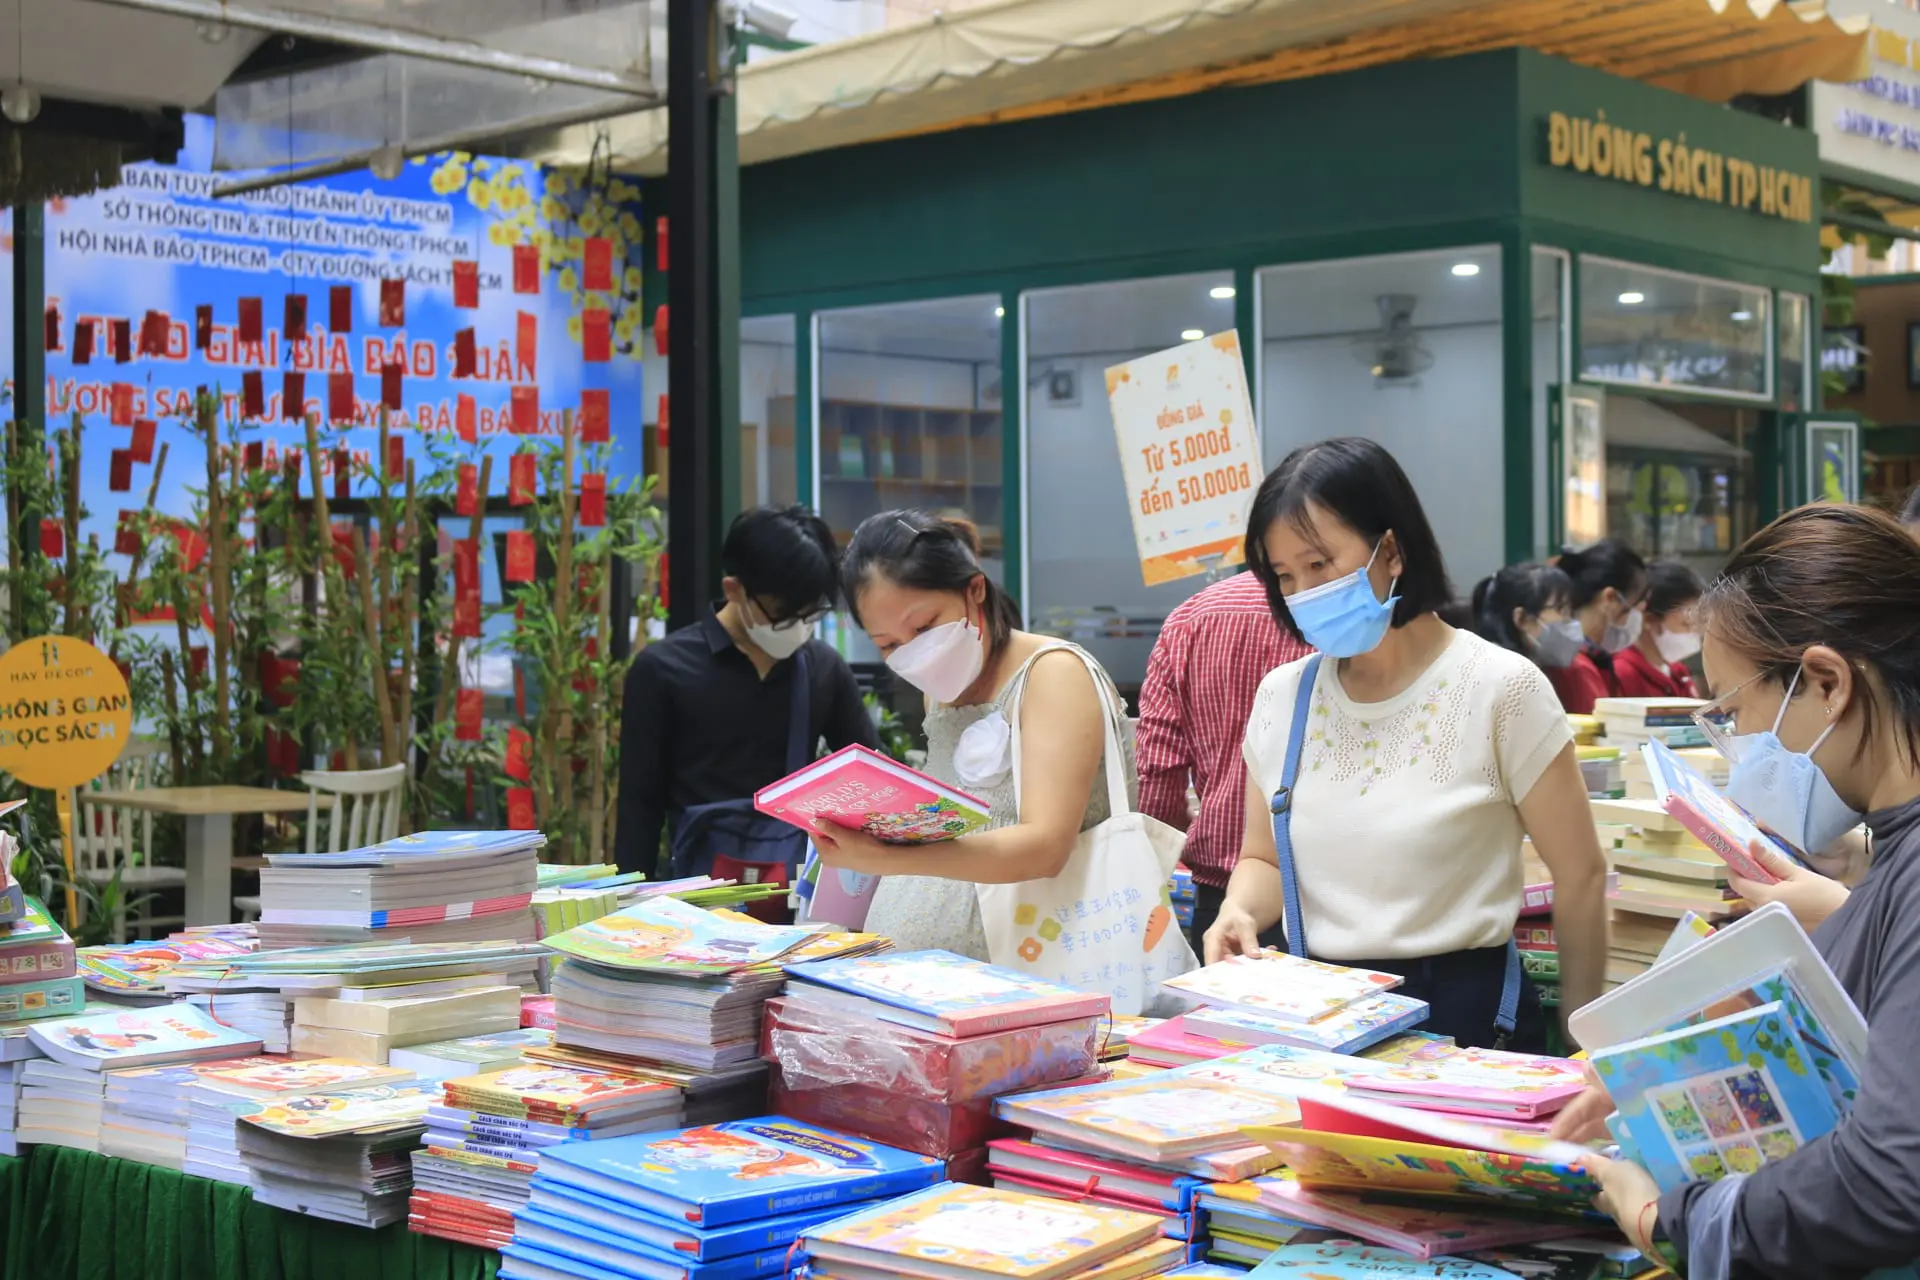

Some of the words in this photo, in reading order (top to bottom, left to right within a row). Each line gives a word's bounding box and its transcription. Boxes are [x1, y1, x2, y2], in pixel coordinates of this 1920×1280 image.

[1658, 131, 1723, 203] SÁCH
[126, 168, 168, 191] BAN
[294, 187, 357, 213] THÀNH
[391, 203, 450, 223] TPHCM
[103, 197, 130, 219] SỞ
[136, 201, 207, 227] THÔNG
[211, 212, 242, 234] TIN
[248, 217, 260, 235] &
[343, 226, 405, 251] THÔNG
[409, 234, 469, 256] TPHCM
[59, 229, 97, 254] HỘI
[104, 232, 147, 257] NHÀ
[153, 236, 195, 261] BÁO
[200, 243, 267, 269] TPHCM
[282, 254, 316, 274] CTY
[446, 268, 503, 290] TCM
[365, 329, 435, 378] BÁO
[447, 338, 536, 382] UÂN
[480, 405, 536, 435] BÁ
[1141, 442, 1165, 475] Từ
[1169, 425, 1232, 468] 5.000đ
[1140, 476, 1174, 516] đến
[1177, 461, 1251, 507] 50.000đ
[10, 671, 37, 683] HAY
[0, 697, 66, 720] HÔNG
[72, 694, 128, 715] GIAN
[56, 719, 116, 742] SÁCH
